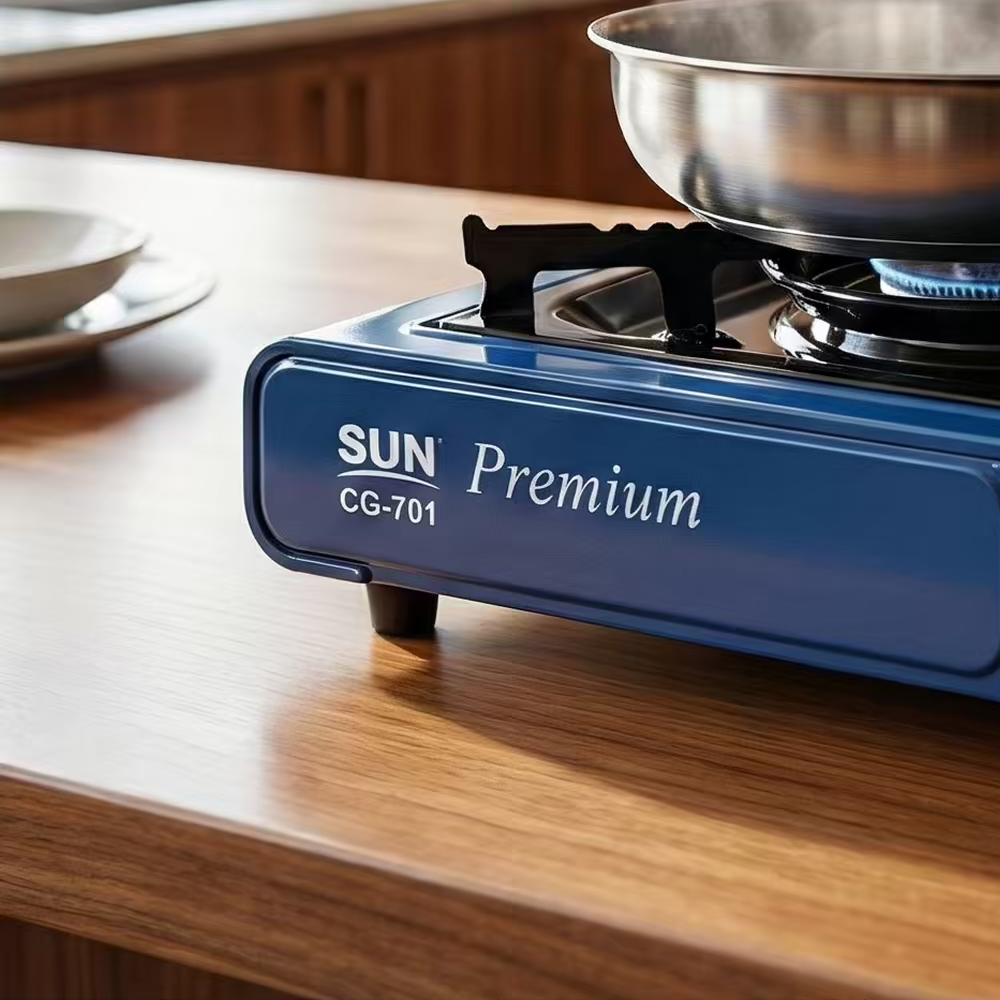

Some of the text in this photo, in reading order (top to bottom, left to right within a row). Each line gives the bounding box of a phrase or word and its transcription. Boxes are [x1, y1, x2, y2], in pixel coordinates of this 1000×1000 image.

[337, 423, 435, 477] SUN
[340, 487, 435, 526] CG-701
[466, 442, 701, 529] Premium
